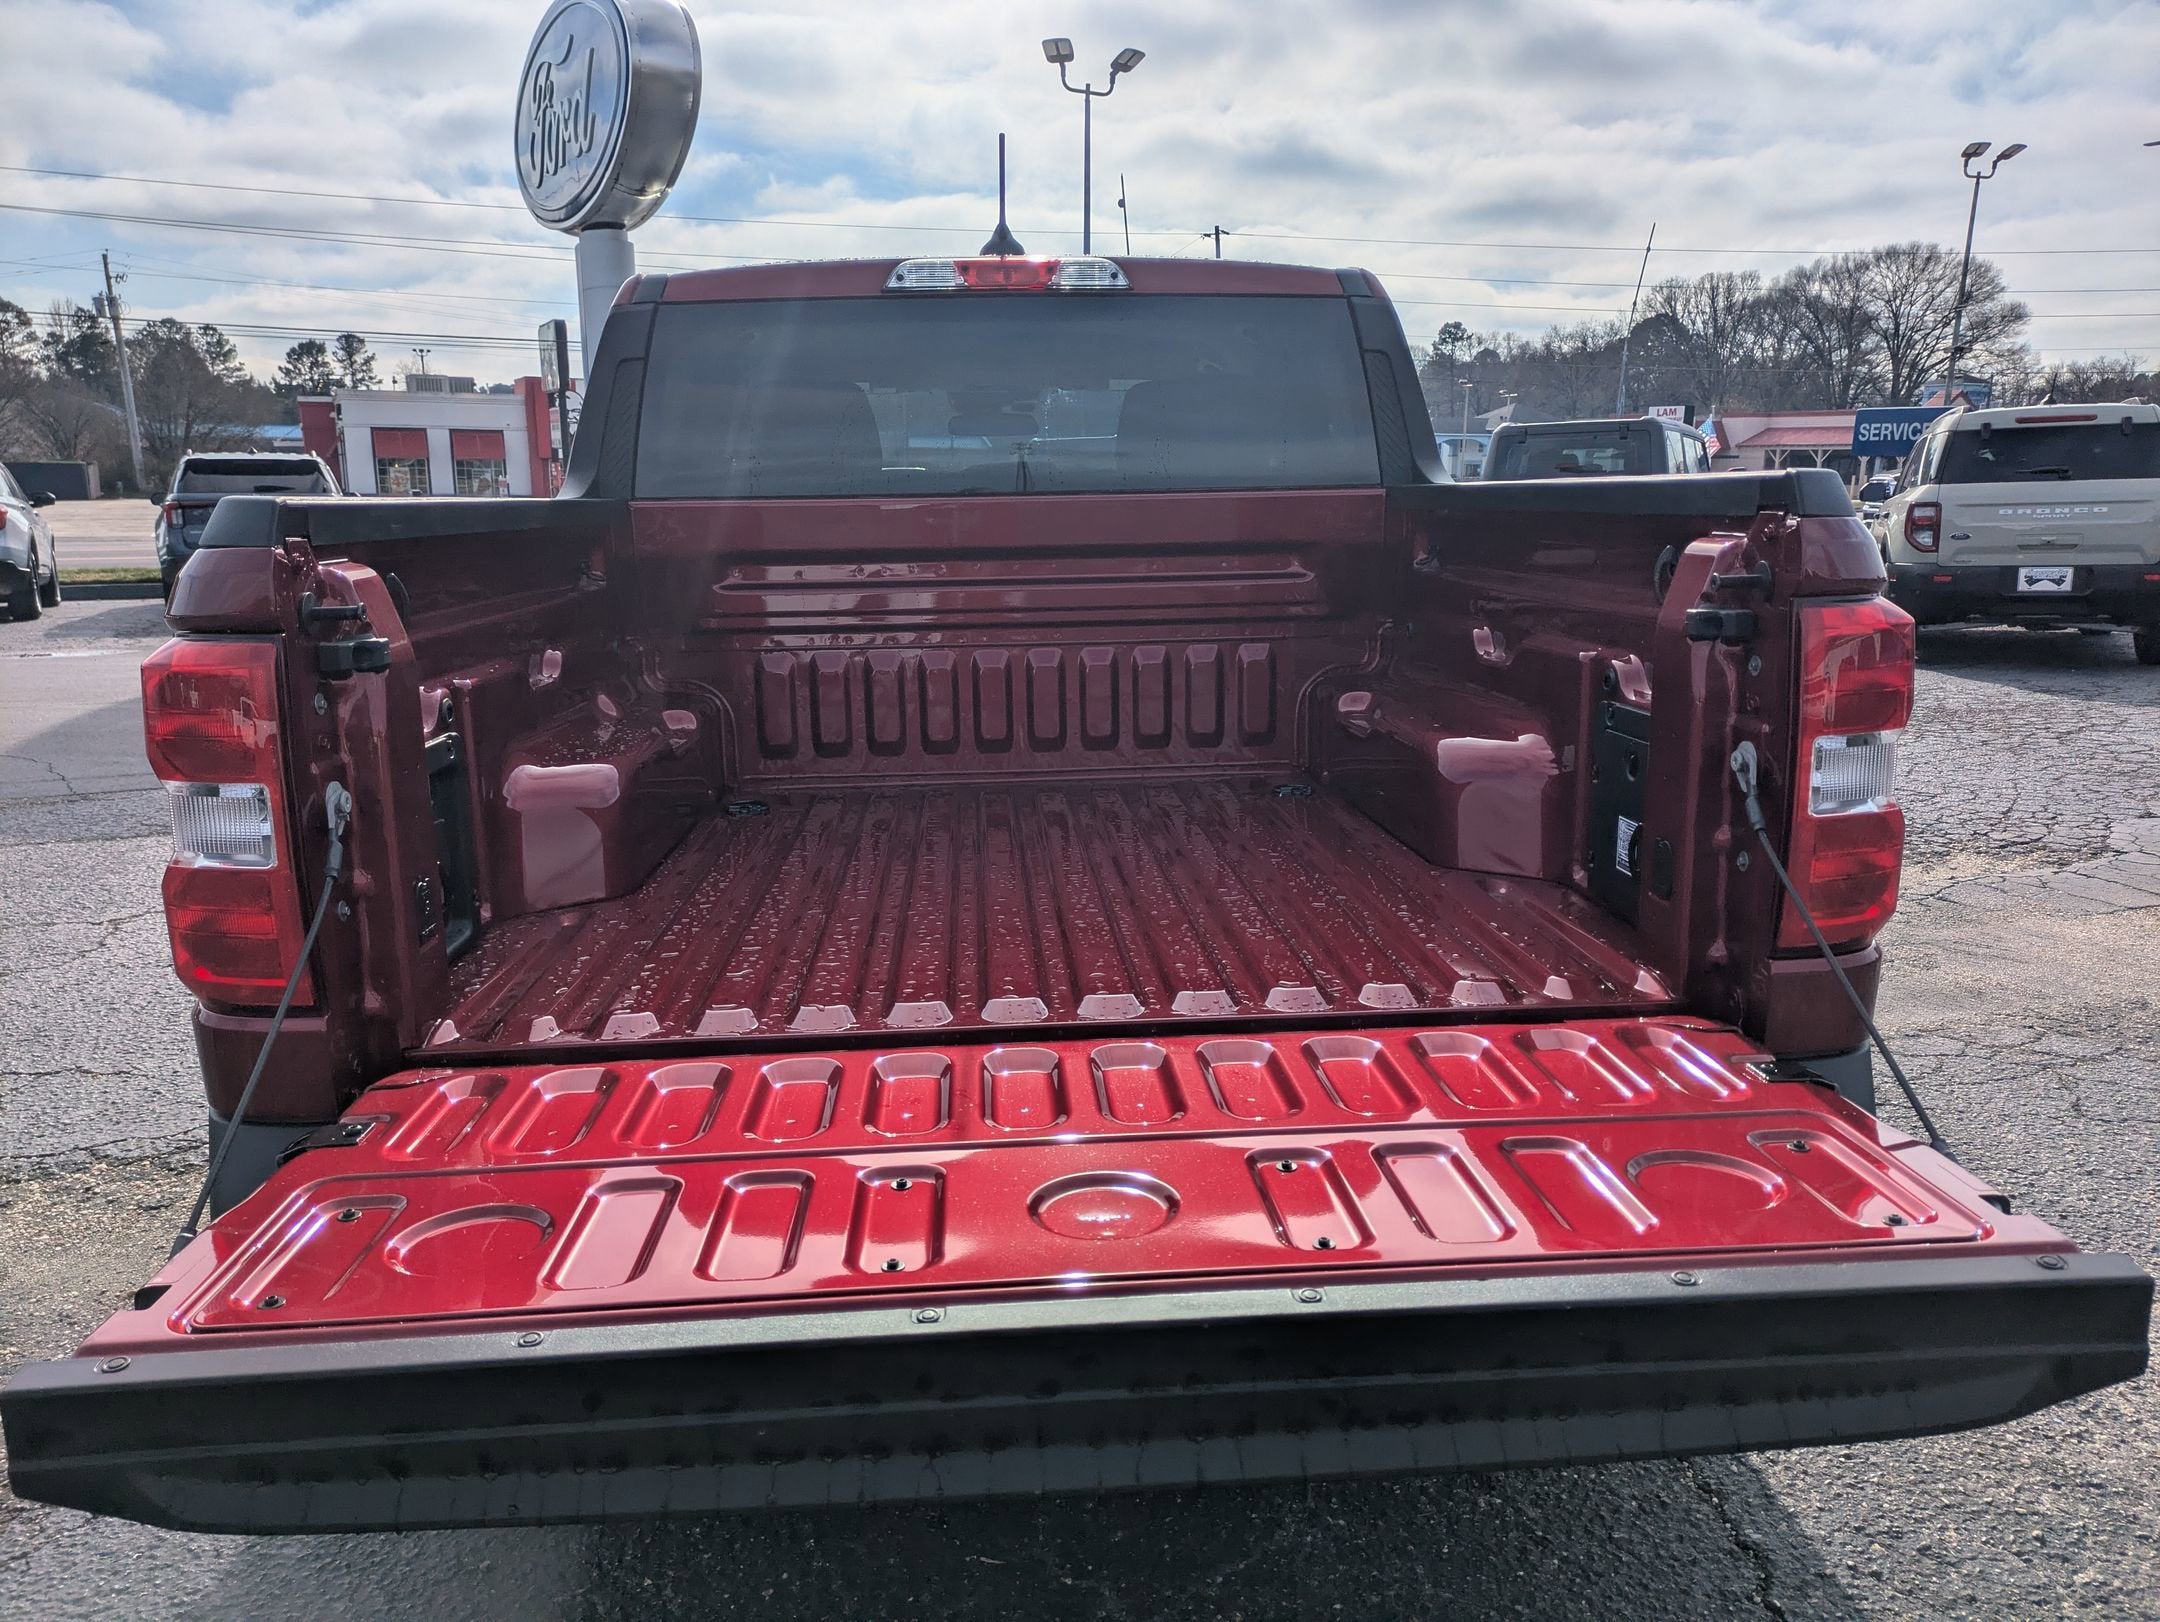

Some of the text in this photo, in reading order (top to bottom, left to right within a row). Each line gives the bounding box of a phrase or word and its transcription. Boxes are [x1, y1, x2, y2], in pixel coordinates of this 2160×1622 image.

[530, 34, 596, 189] Ford
[1656, 408, 1678, 417] LAM
[1999, 506, 2108, 515] BRONCO
